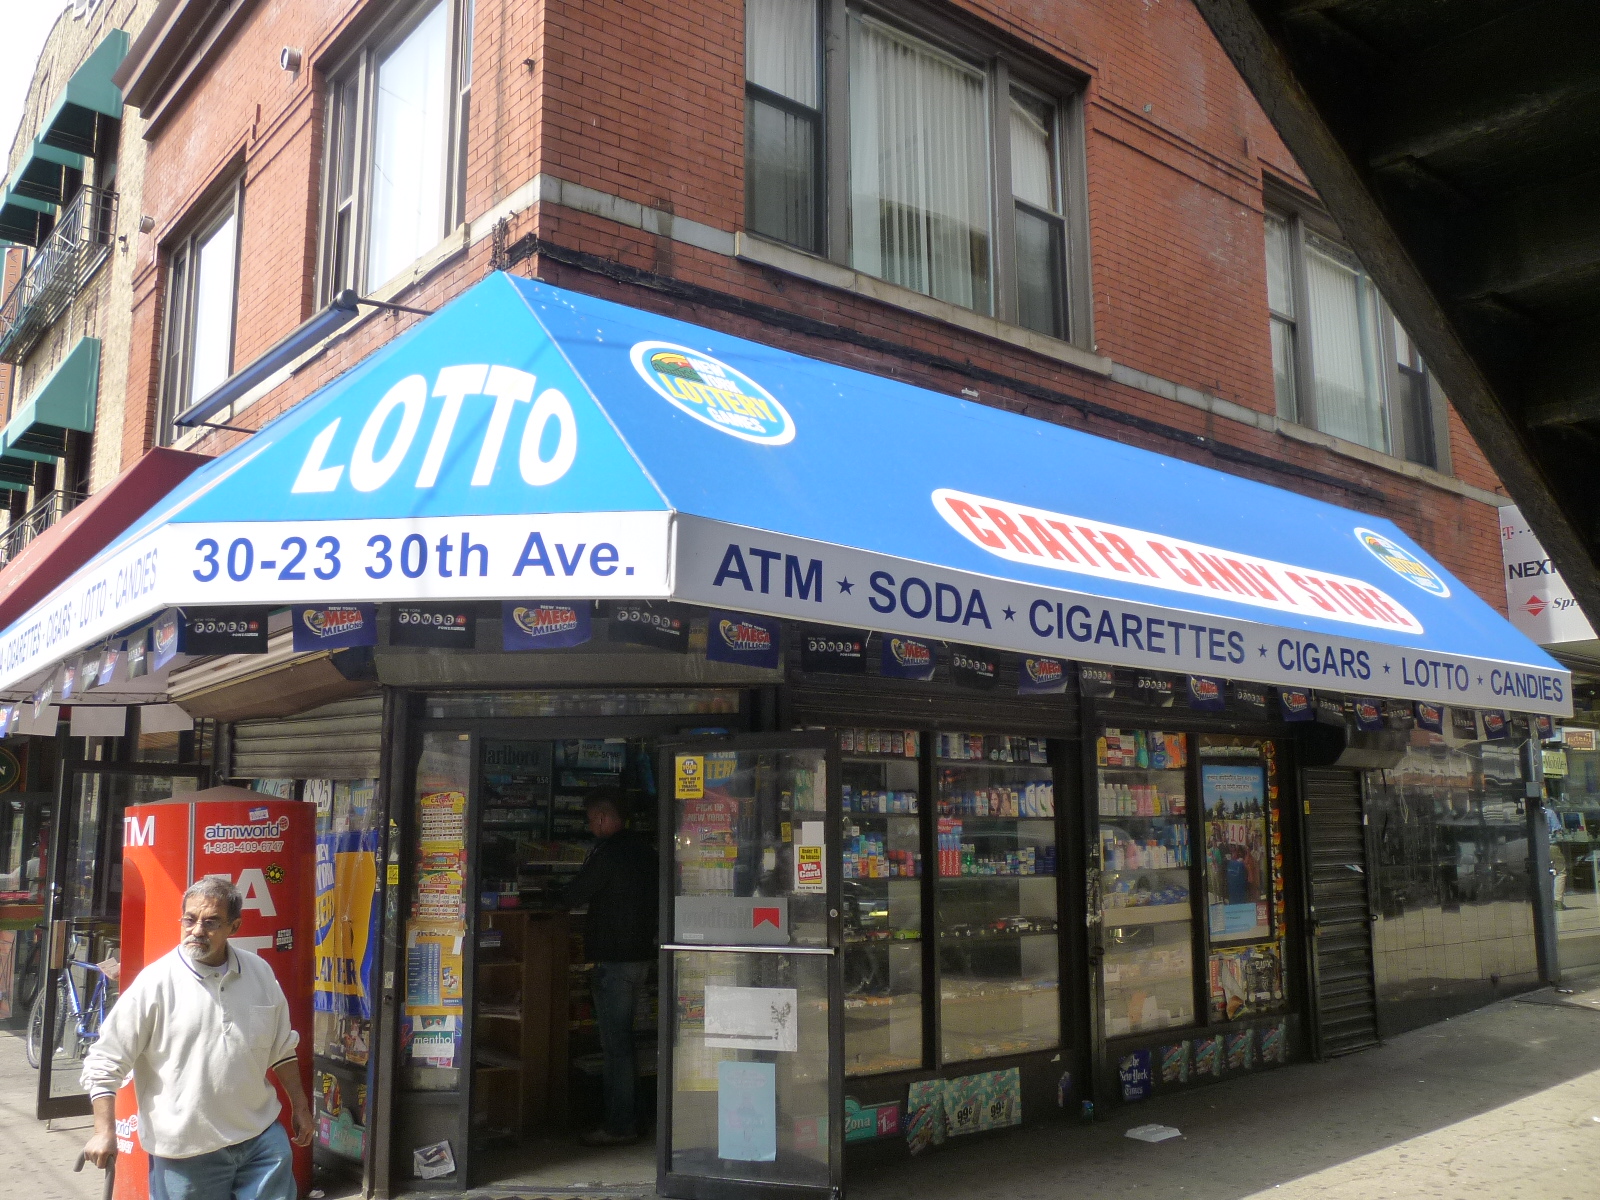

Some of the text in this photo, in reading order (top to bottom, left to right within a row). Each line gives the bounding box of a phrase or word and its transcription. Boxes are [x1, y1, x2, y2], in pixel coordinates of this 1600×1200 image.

[685, 357, 727, 378] NEW
[697, 372, 744, 395] YORK
[658, 373, 778, 423] LOTTERY
[290, 363, 578, 493] LOTTO
[706, 406, 767, 434] GAMES
[192, 531, 636, 582] 30-23 30th Ave.
[944, 497, 1413, 627] CRATER CANDY STORE
[6, 620, 43, 673] CIGARETTES
[79, 578, 107, 629] LOTTO
[115, 547, 158, 609] CANDIES
[323, 610, 363, 626] MEGA
[535, 609, 577, 625] MEGA
[320, 622, 364, 638] MILLIONS
[531, 622, 578, 637] MILLIONS
[712, 543, 1564, 703] ATM SODA CIGARETTES CIGARS LOTTO CANDIES
[736, 625, 771, 643] MEGA
[733, 641, 772, 651] MILLIONS
[903, 643, 930, 658] MEGA
[1037, 661, 1063, 675] MEGA
[204, 823, 280, 840] atmworld
[204, 841, 284, 854] 1-888-409-6747
[799, 869, 821, 878] Card
[802, 863, 817, 872] We
[413, 1032, 455, 1045] menthol
